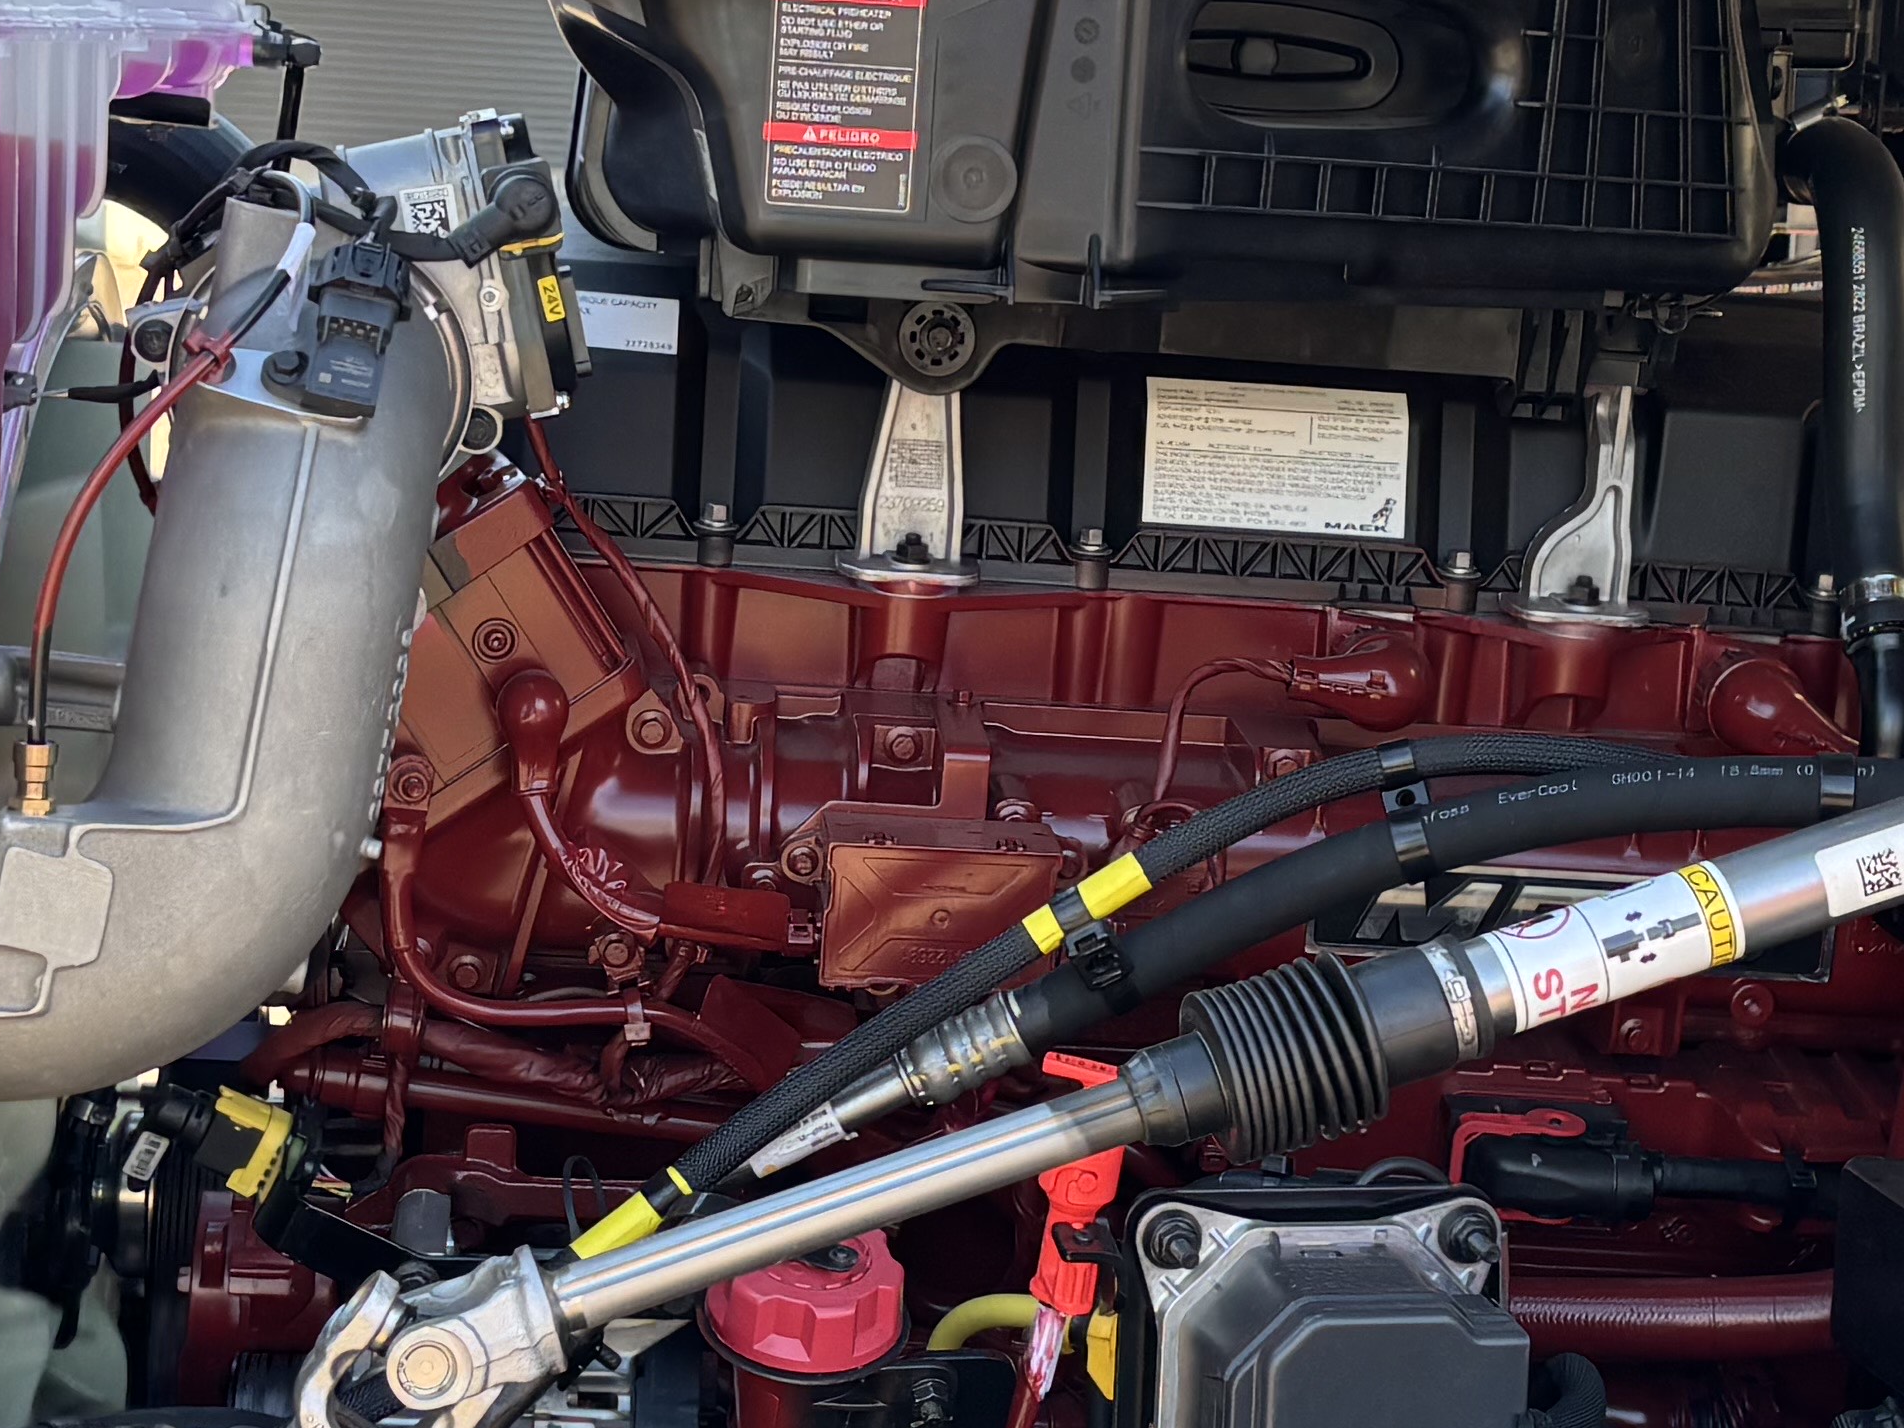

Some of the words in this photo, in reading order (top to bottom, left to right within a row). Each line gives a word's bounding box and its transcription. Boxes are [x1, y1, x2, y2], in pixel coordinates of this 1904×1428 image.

[782, 3, 835, 16] ELECTRICAL
[820, 131, 880, 143] PELIGRO
[543, 285, 561, 314] 24V
[611, 299, 658, 309] CAPACITY
[1325, 522, 1388, 532] MACK
[1498, 780, 1577, 806] EverCool
